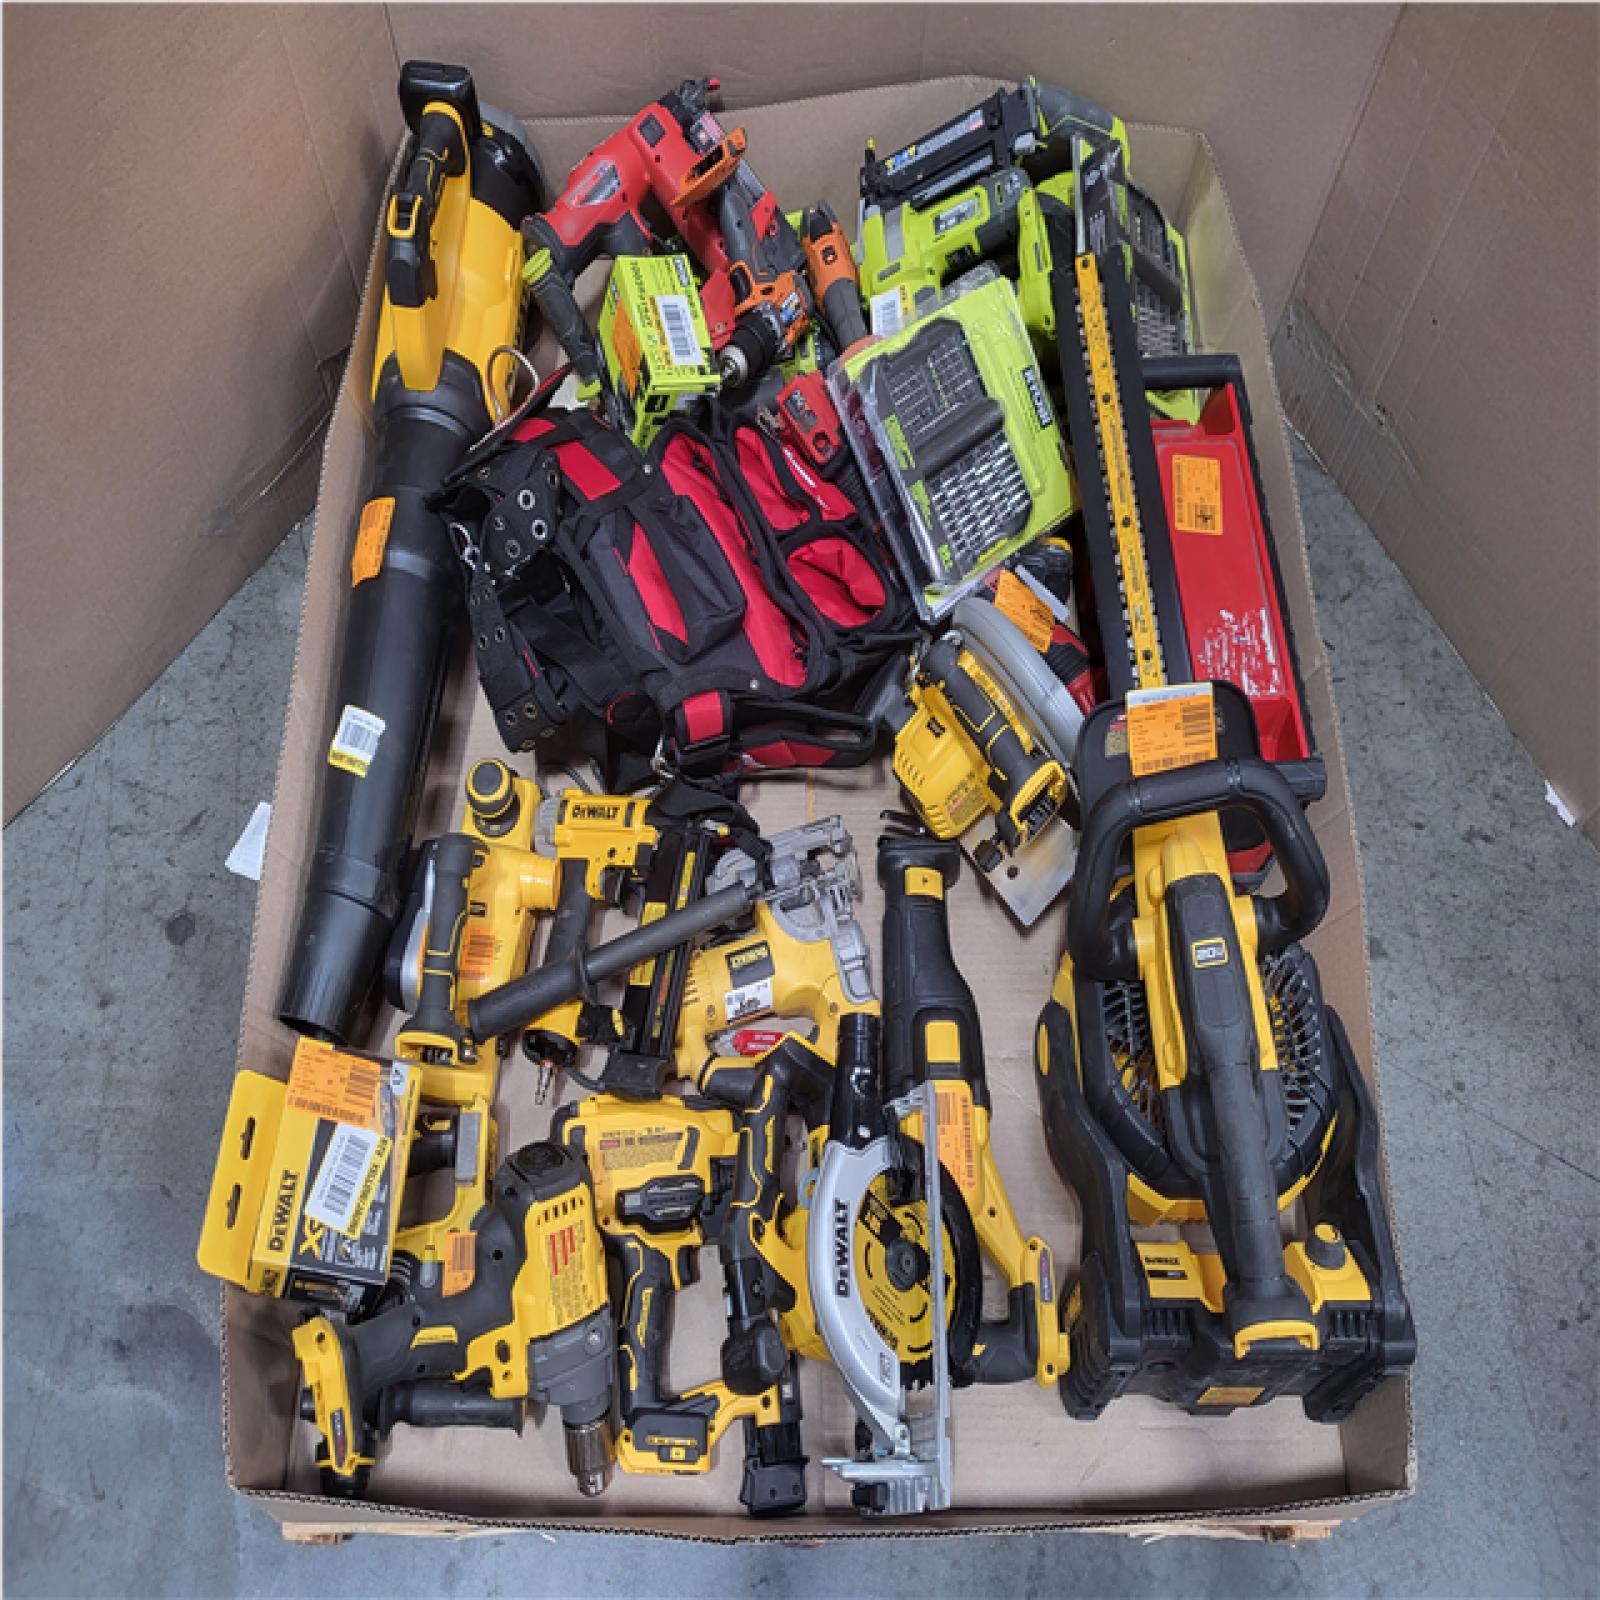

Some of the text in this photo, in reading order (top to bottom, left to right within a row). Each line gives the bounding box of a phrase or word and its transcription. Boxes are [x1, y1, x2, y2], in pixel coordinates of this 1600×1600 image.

[572, 803, 620, 819] DEWALT
[268, 1169, 299, 1251] DEWALT
[834, 1199, 850, 1297] DEWALT
